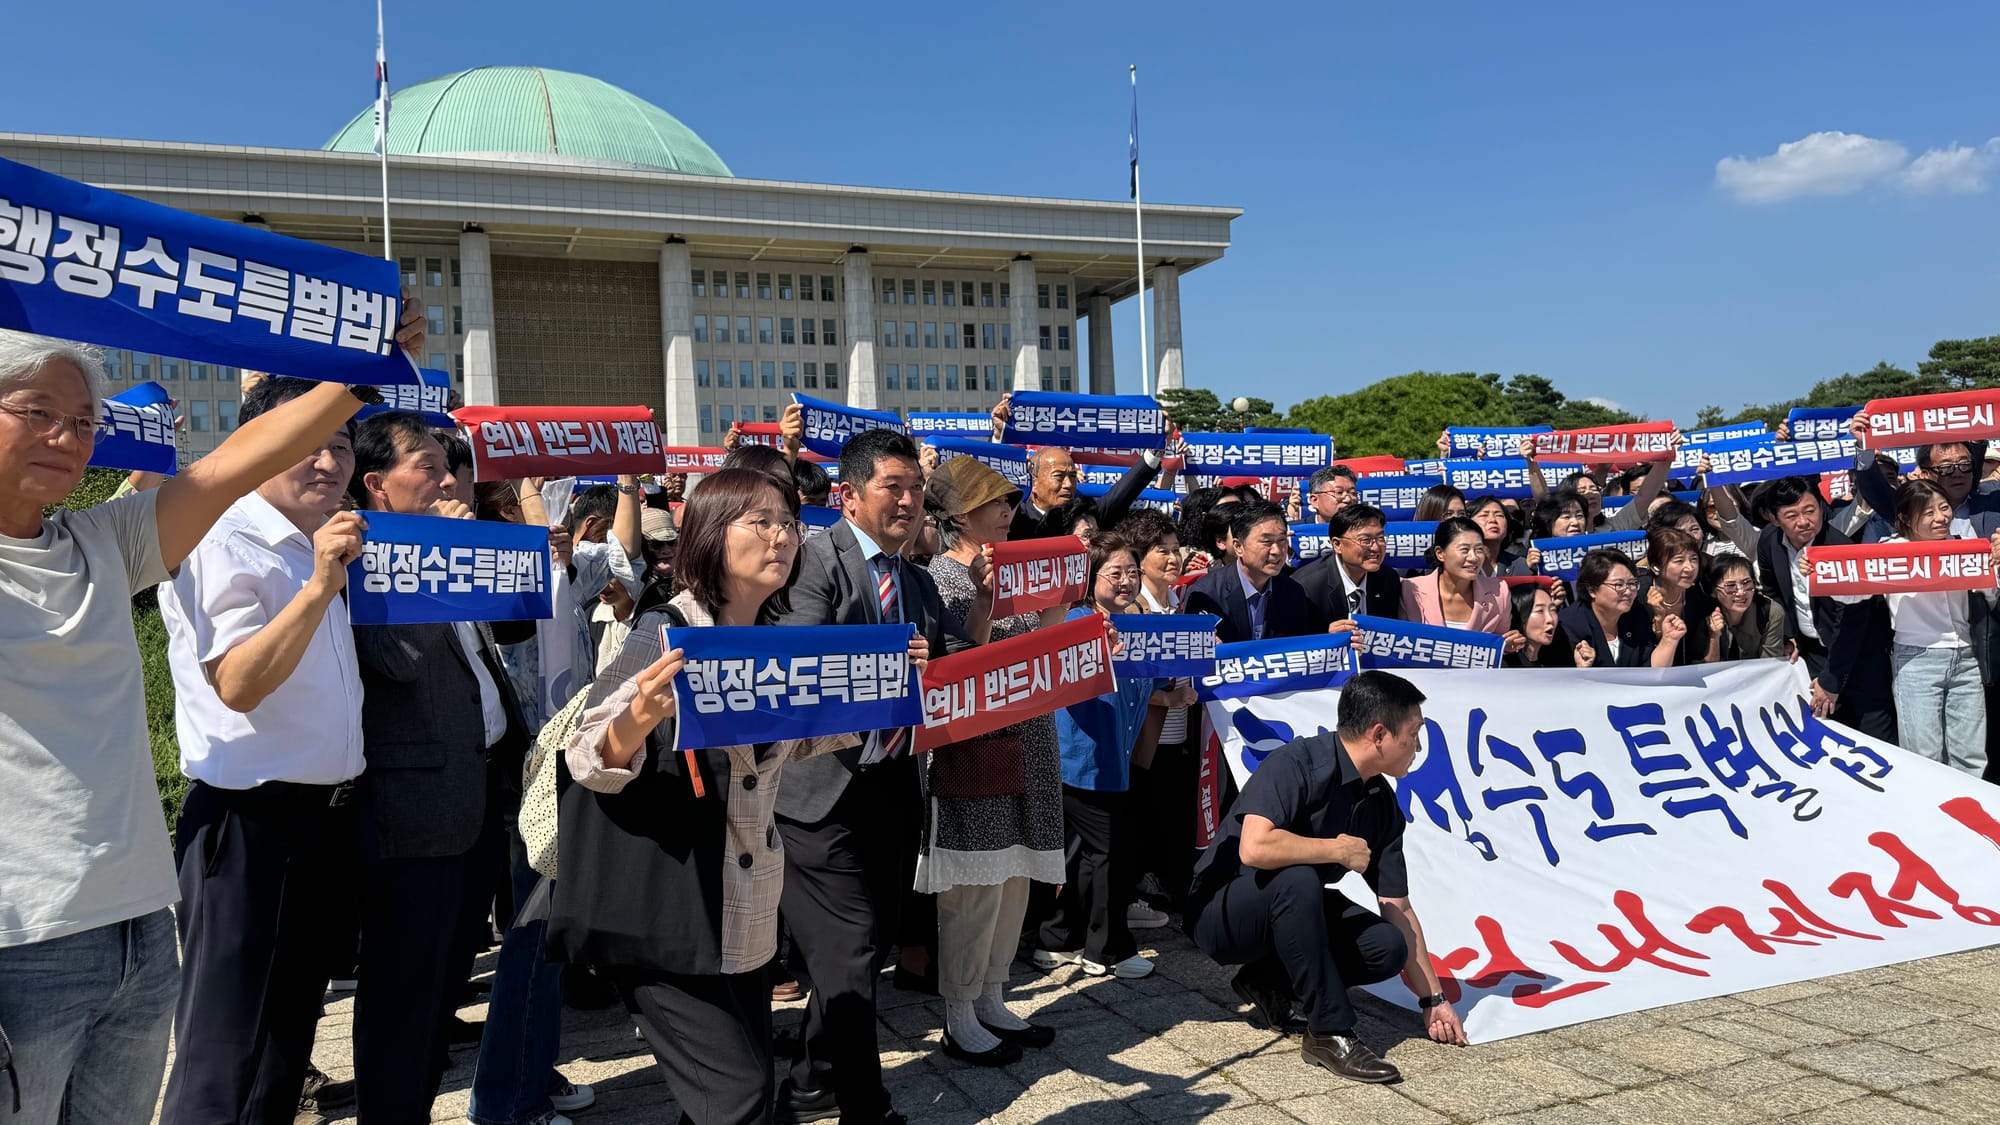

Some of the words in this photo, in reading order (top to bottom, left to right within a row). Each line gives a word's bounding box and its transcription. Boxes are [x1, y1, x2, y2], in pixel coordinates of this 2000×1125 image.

[0, 199, 397, 357] 행정수도특별법!
[1013, 405, 1164, 434] 행정수도특별법!
[1869, 411, 1916, 437] 연내
[1922, 403, 1995, 432] 반드시
[481, 421, 539, 458] 연내
[536, 421, 611, 456] 반드시
[611, 420, 661, 455] 제정!
[1186, 444, 1327, 466] 행정수도특별법!
[1535, 433, 1571, 454] 연내
[1575, 433, 1627, 454] 반드시
[665, 453, 700, 467] 반드시
[361, 540, 545, 594] 행정수도특별법!
[998, 562, 1024, 600] 연내
[1026, 557, 1062, 594] 반드시
[1063, 552, 1088, 587] 제정!
[1815, 559, 1859, 584] 연내
[1864, 555, 1932, 582] 반드시
[1938, 552, 1991, 578] 제정!
[683, 652, 909, 714] 행정수도특별법!
[924, 675, 977, 730] 연내
[984, 653, 1052, 712] 반드시
[1057, 637, 1105, 686] 제정!
